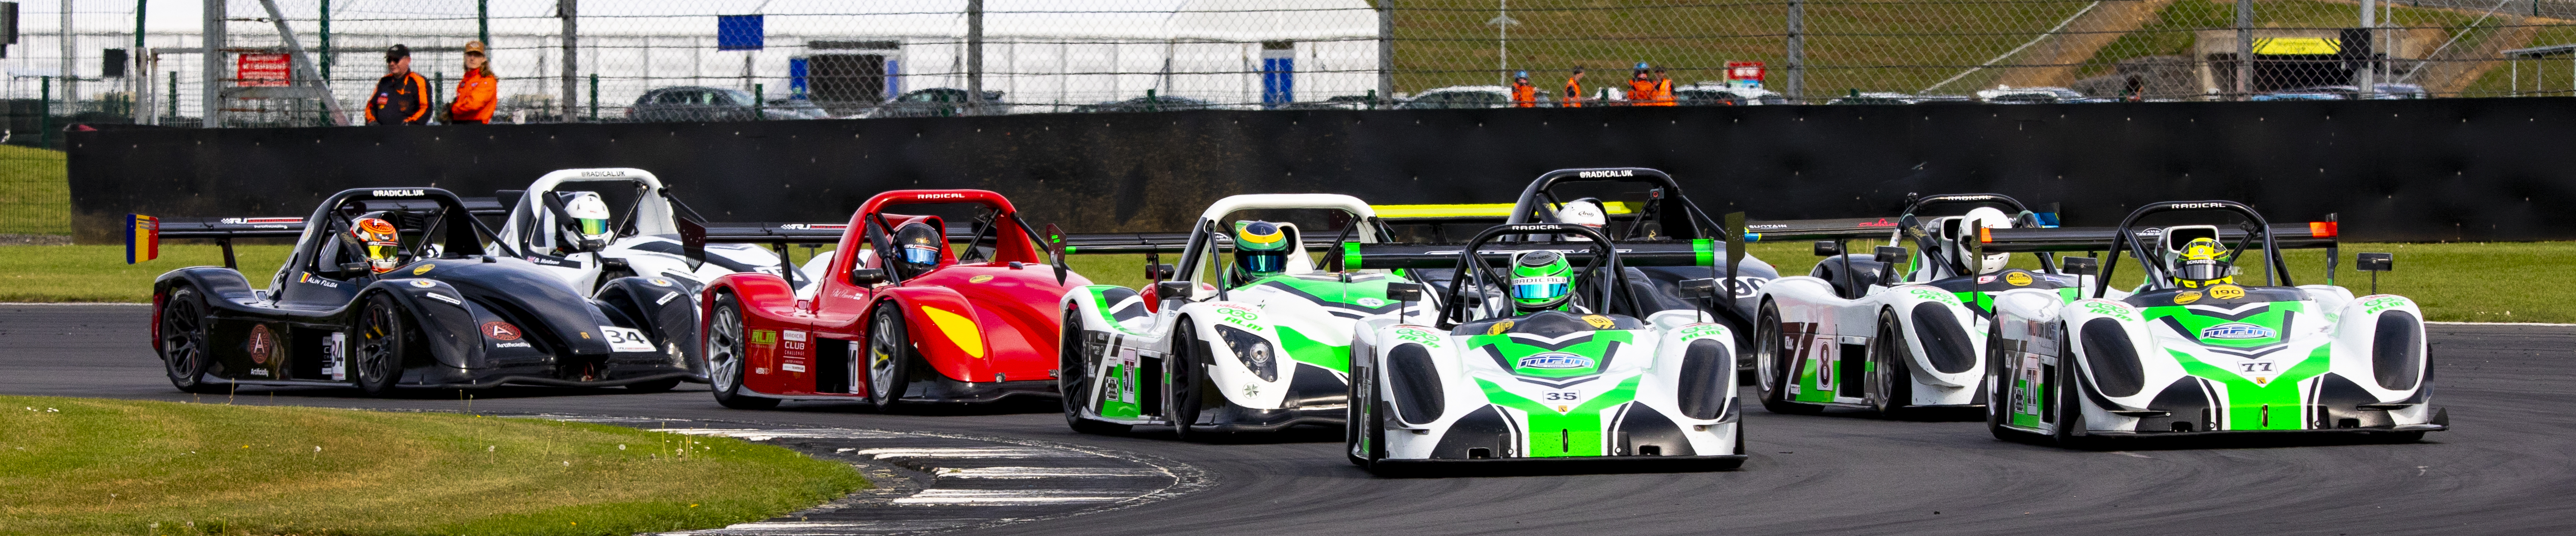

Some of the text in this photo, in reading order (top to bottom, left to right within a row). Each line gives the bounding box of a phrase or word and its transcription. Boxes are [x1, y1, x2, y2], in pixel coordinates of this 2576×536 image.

[605, 330, 645, 344] 34
[785, 341, 805, 350] CLUB
[332, 340, 344, 367] 34
[1821, 342, 1829, 388] 8
[2241, 362, 2273, 372] 77
[1545, 392, 1578, 400] 35
